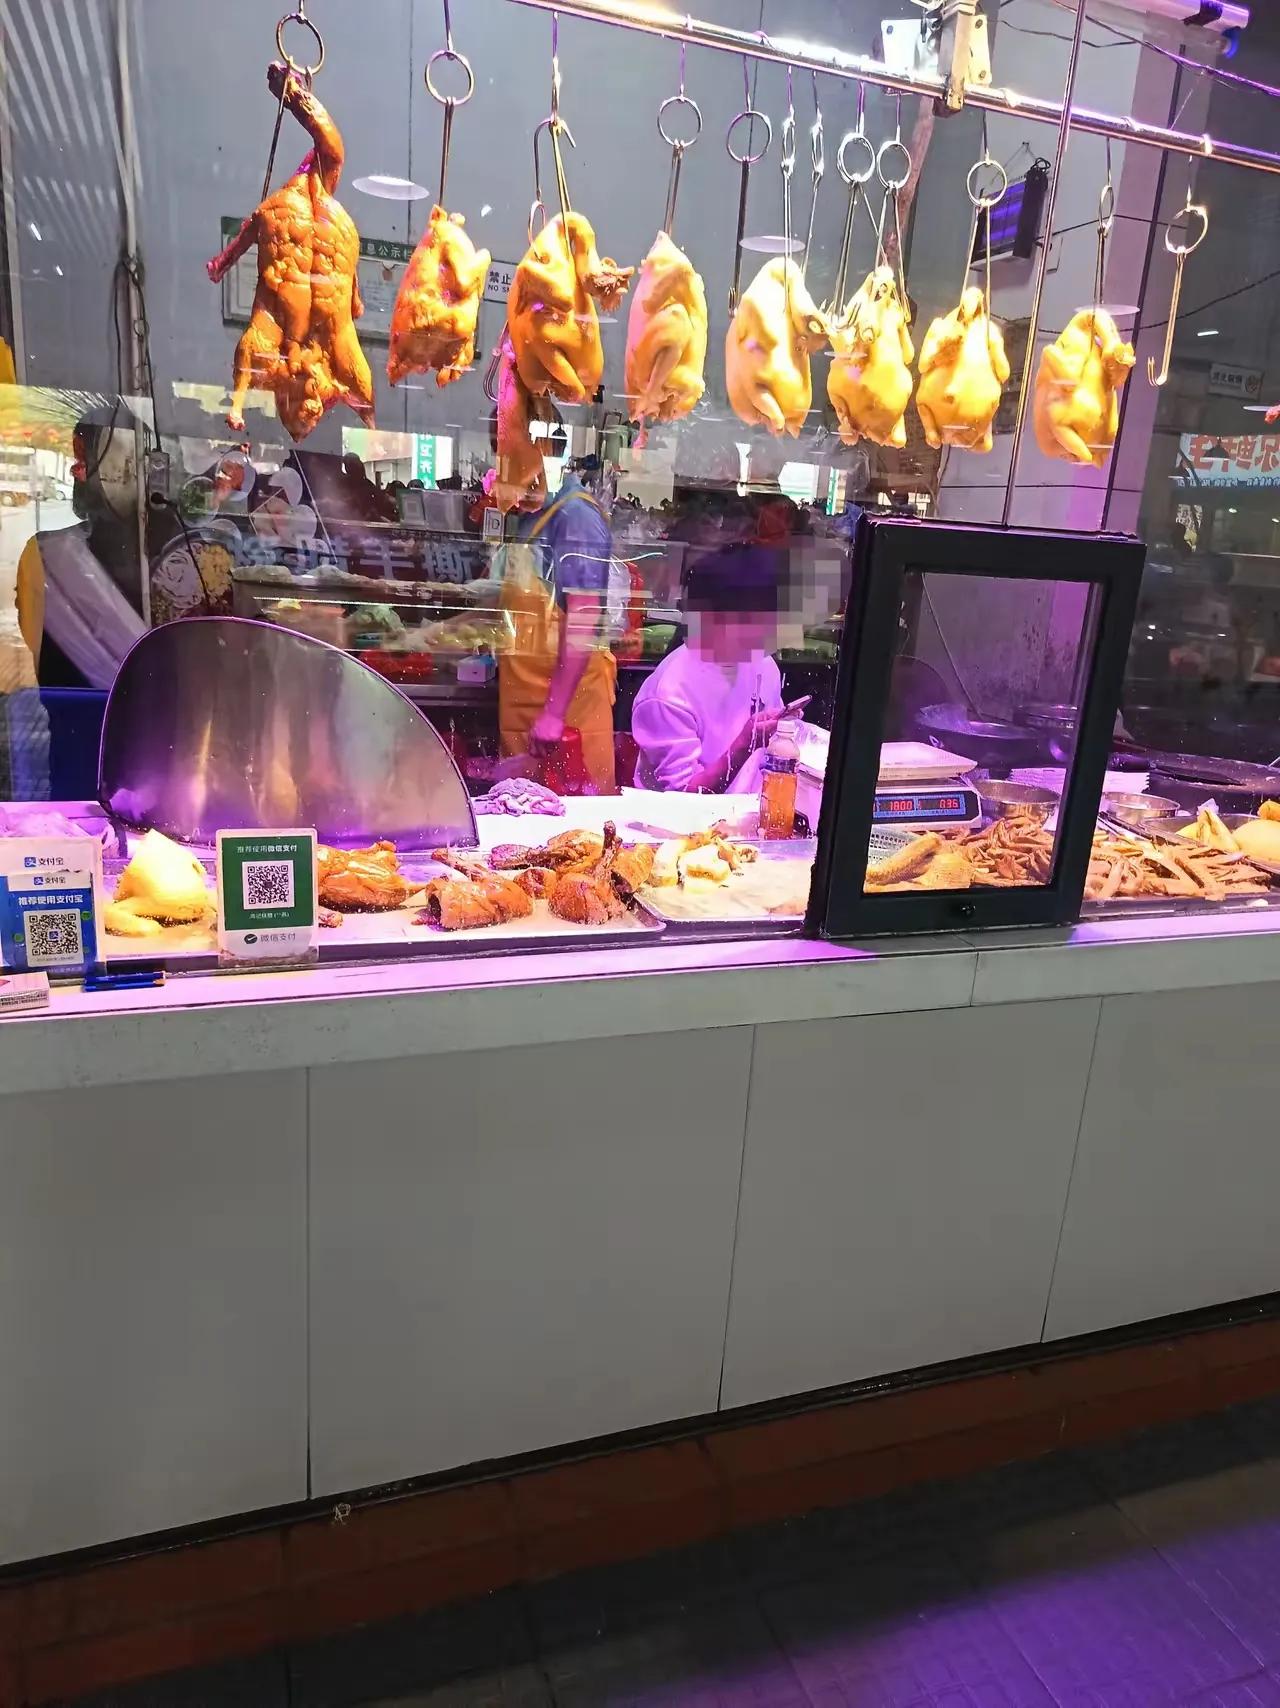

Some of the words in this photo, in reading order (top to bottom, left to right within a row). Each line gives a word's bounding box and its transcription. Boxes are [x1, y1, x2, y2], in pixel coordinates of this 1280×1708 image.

[489, 270, 512, 286] 禁止
[236, 844, 298, 854] 推荐使用微信支付
[38, 857, 64, 866] 支付宝
[18, 894, 84, 906] 推荐使用支付宝
[260, 933, 296, 942] 微信支付
